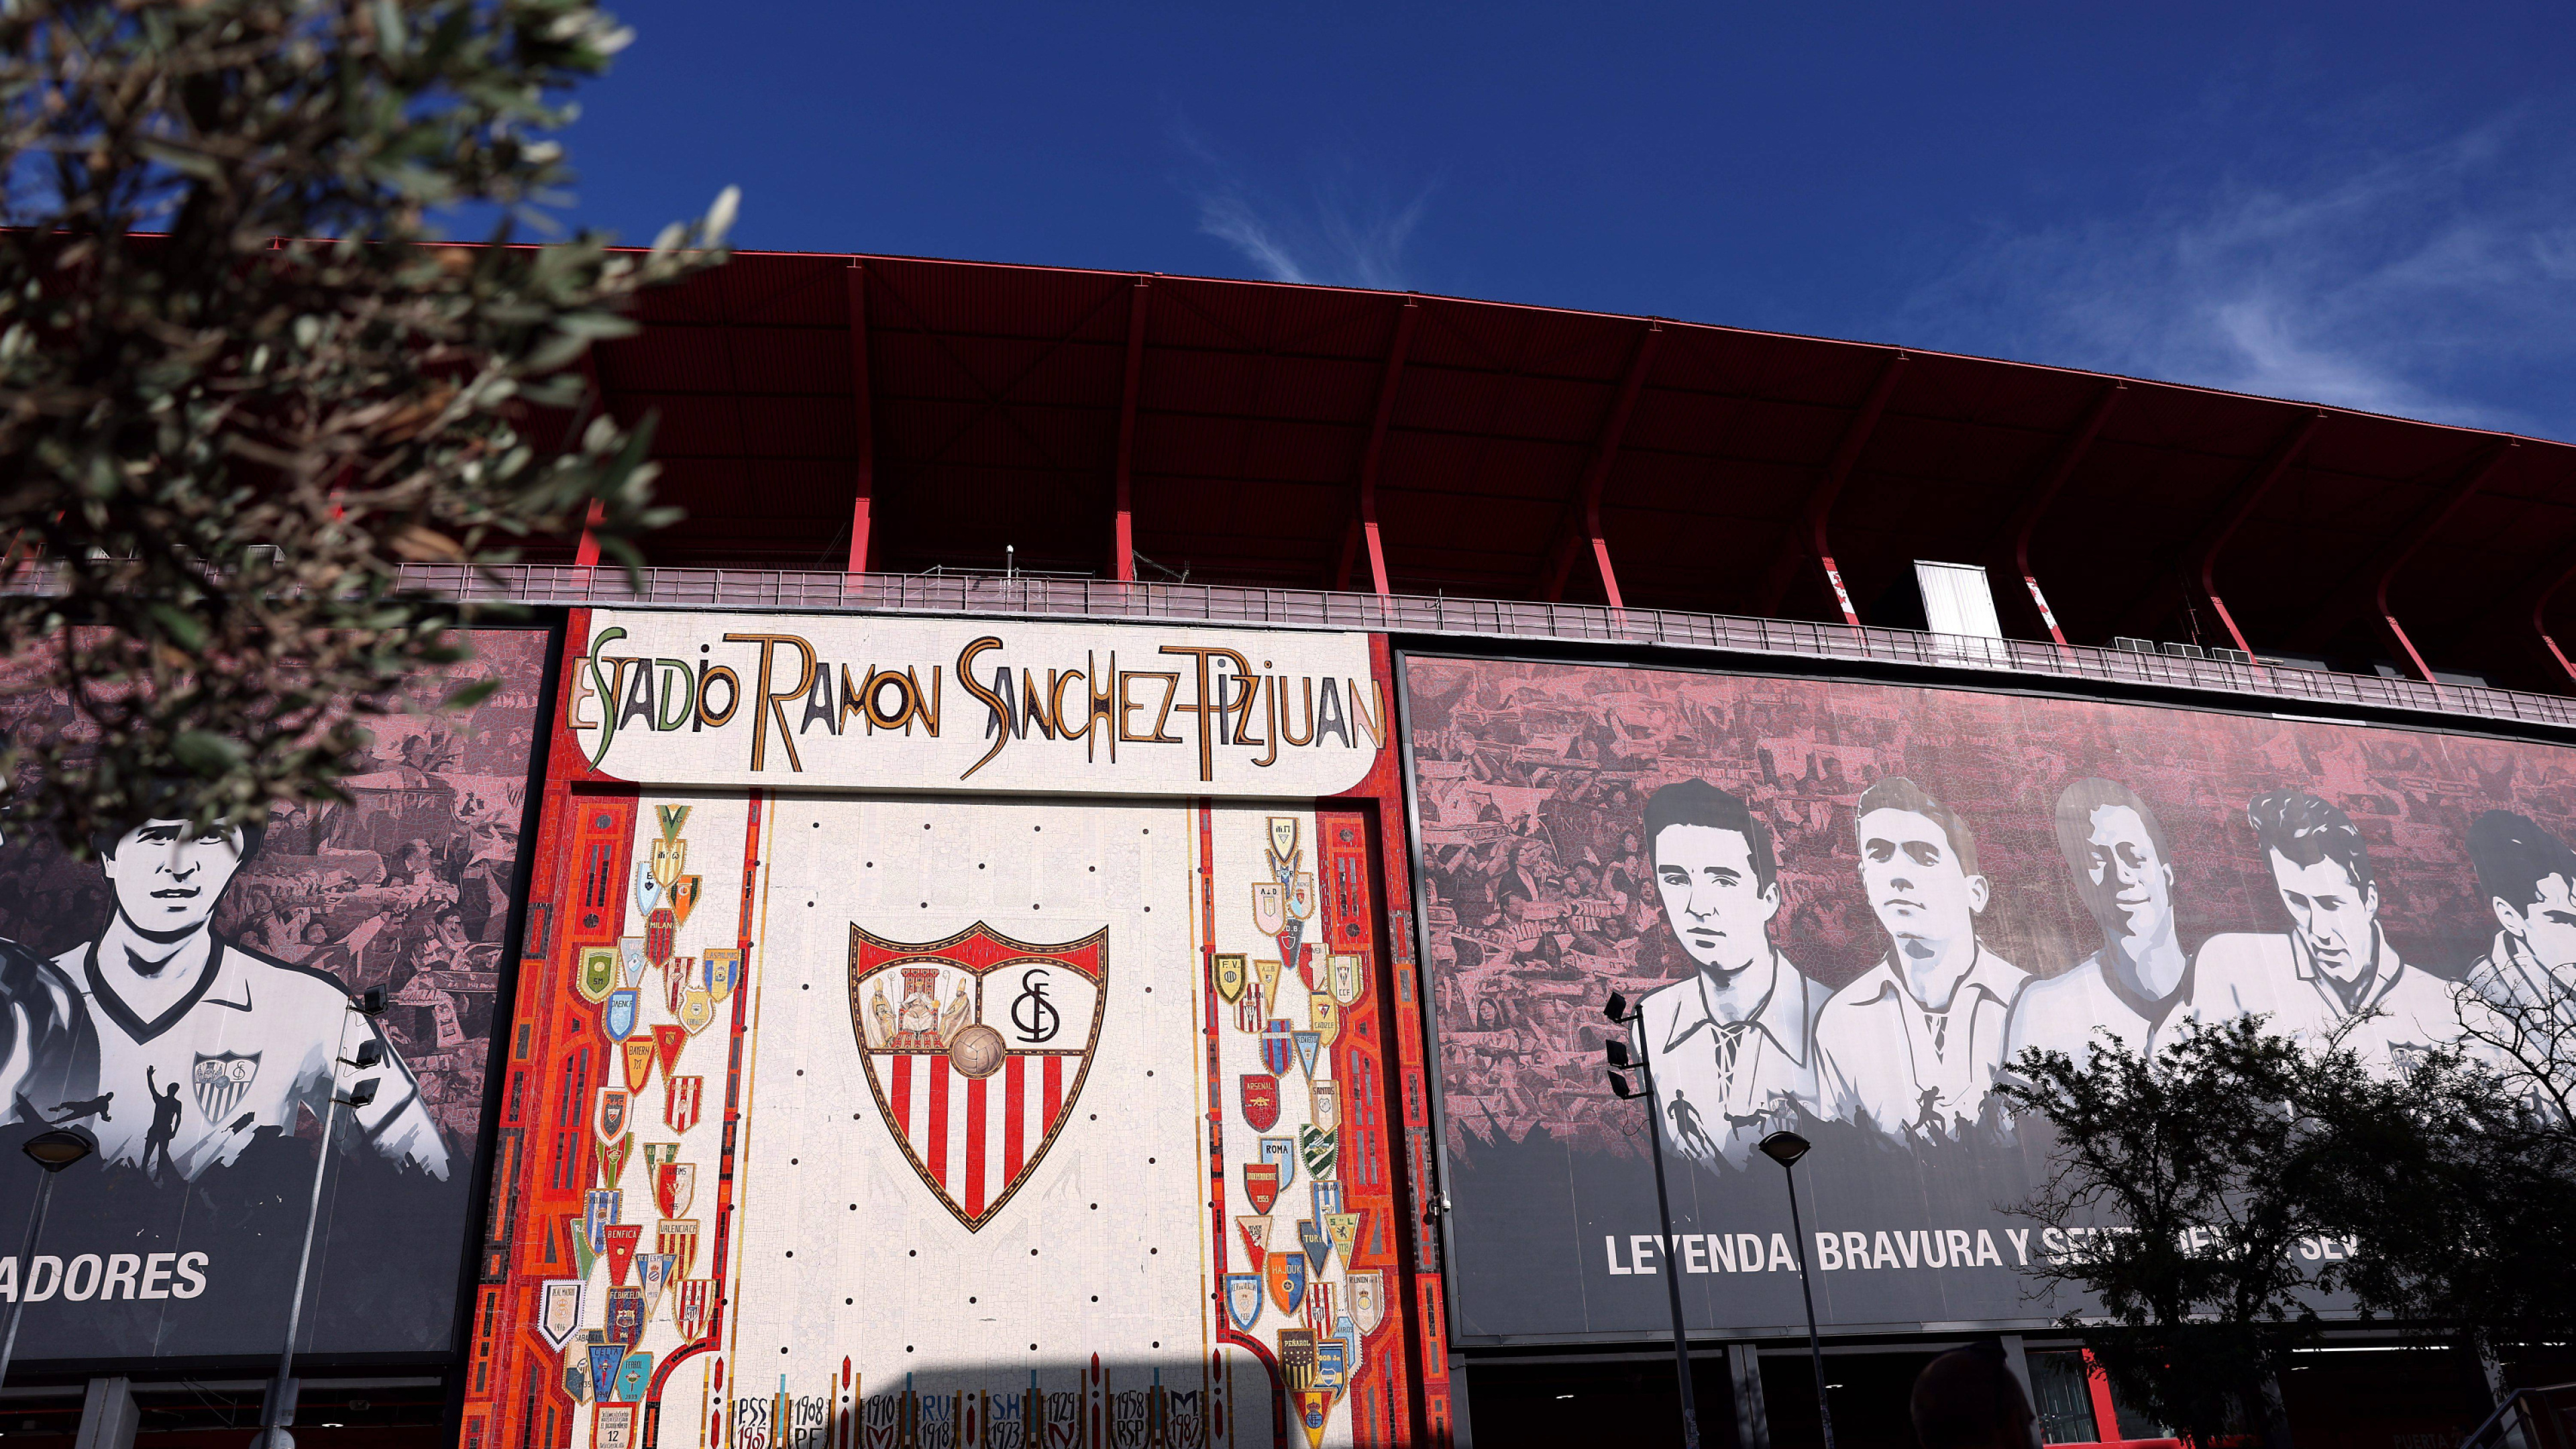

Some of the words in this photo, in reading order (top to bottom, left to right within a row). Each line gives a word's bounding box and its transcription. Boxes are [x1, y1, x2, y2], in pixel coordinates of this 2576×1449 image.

[722, 633, 941, 773] RAMON
[1266, 1145, 1289, 1154] ROMA
[607, 1230, 637, 1238] BENFICA
[1815, 1229, 2004, 1271] BRAVURA
[2009, 1228, 2031, 1266] Y
[594, 1348, 618, 1356] CELTA
[795, 1395, 824, 1426] 1908
[865, 1395, 896, 1426] 1910
[1046, 1392, 1075, 1422] 1929
[1115, 1390, 1144, 1419] 1958
[607, 1430, 619, 1442] 12
[921, 1421, 949, 1448] 1918
[991, 1421, 1020, 1449] 1923
[1170, 1413, 1199, 1449] 1982
